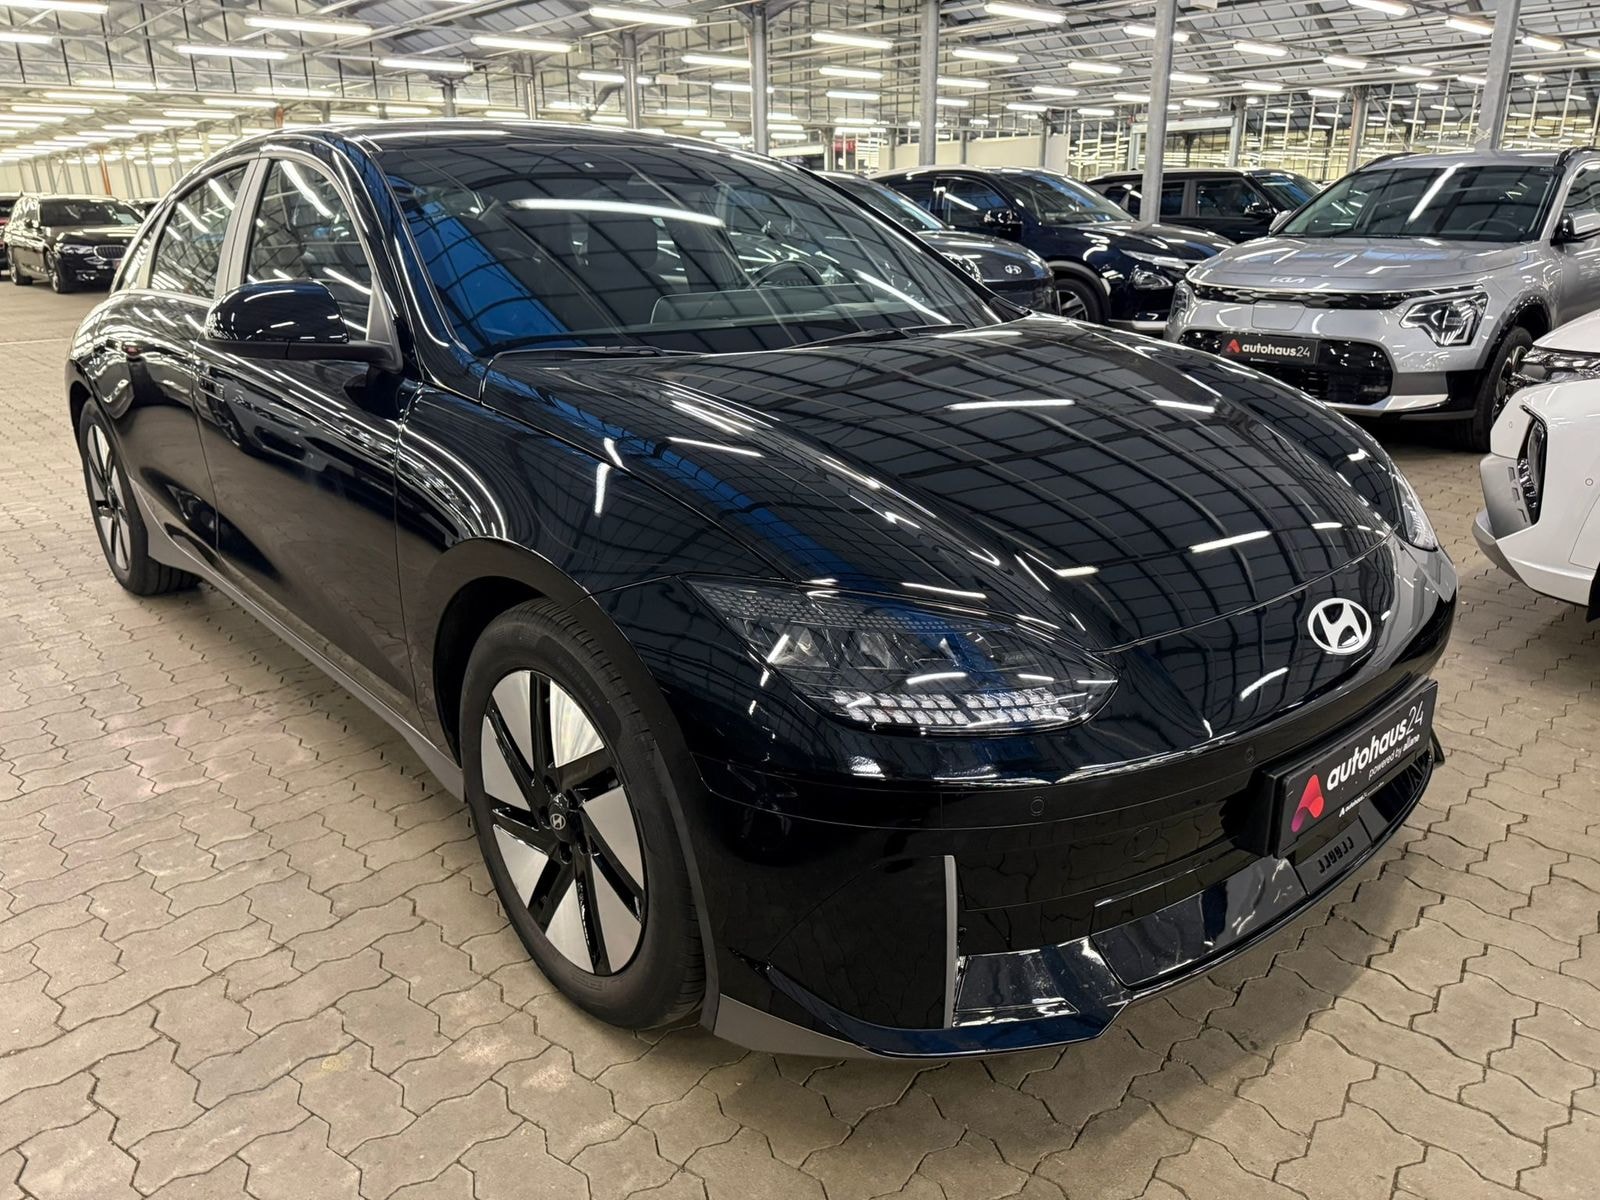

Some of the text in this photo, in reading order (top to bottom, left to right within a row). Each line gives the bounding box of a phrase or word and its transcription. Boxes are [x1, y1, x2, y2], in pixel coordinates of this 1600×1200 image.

[1242, 343, 1310, 357] autohaus24
[1326, 700, 1425, 791] autohaus24
[1368, 749, 1395, 780] powered
[1395, 744, 1403, 758] by
